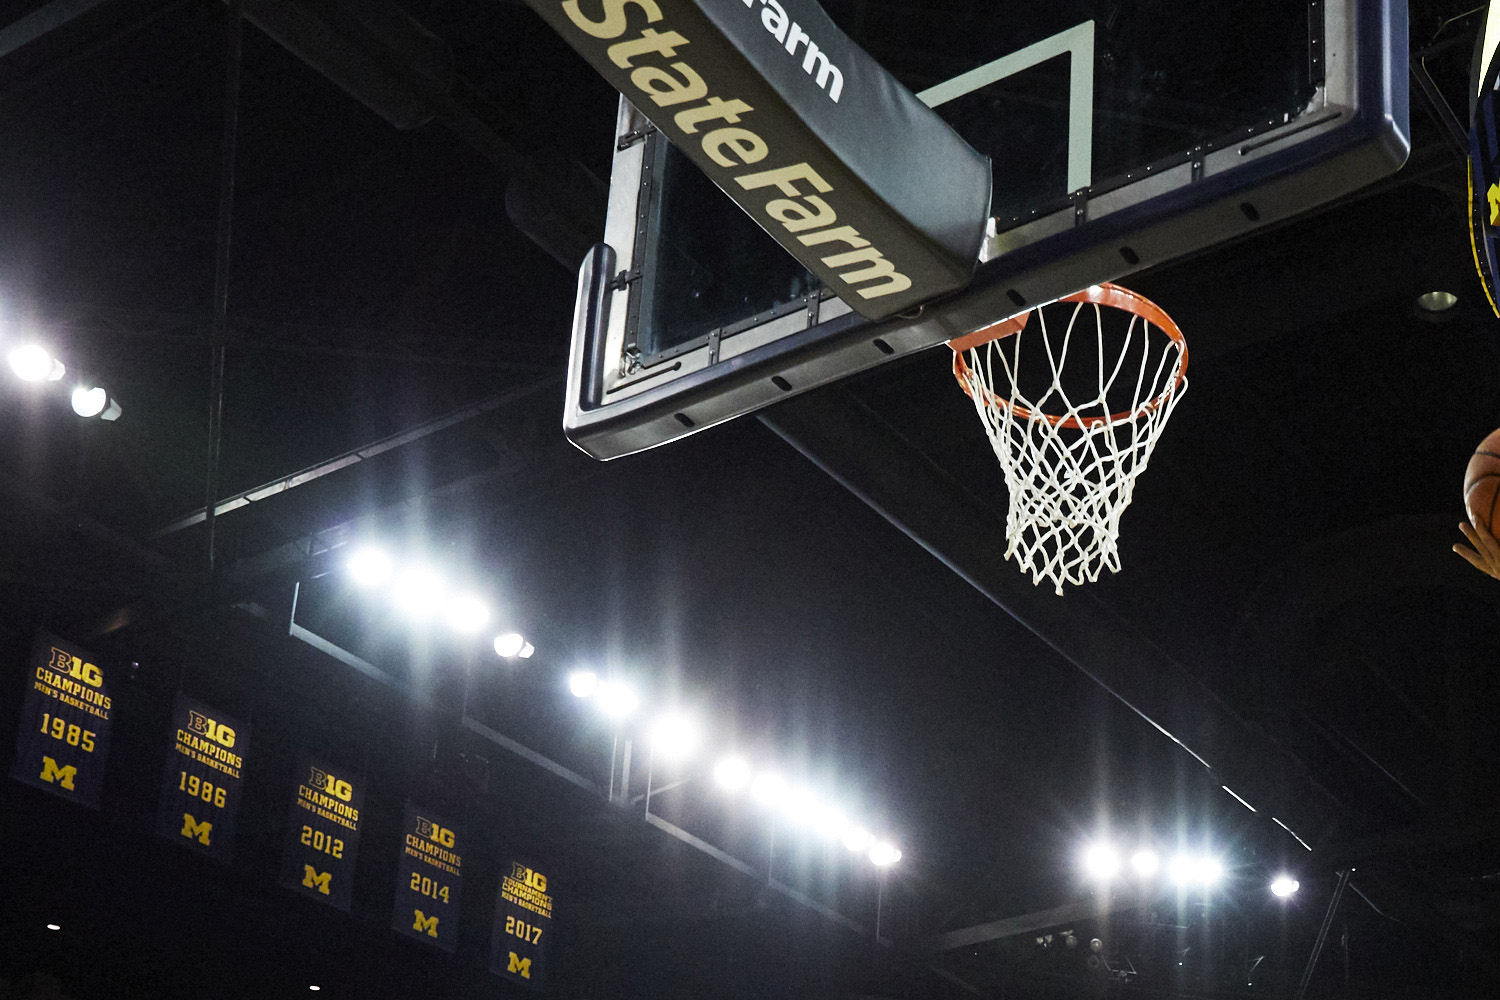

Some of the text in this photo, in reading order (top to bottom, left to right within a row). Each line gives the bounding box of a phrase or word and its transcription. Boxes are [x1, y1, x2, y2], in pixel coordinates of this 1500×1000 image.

[742, 0, 845, 103] arm
[36, 666, 111, 710] CHAMPIONS
[59, 692, 109, 720] BASKETBALL
[40, 713, 96, 752] 1985
[177, 728, 242, 769] CHAMPIONS
[39, 755, 77, 791] M
[197, 753, 241, 779] BASKETBALL
[179, 771, 227, 808] 1986
[298, 784, 359, 822] CHAMPIONS
[181, 813, 213, 846] M
[301, 825, 344, 859] 2012
[406, 833, 462, 867] CHAMPIONS
[302, 864, 332, 896] M
[411, 872, 450, 904] 2014
[501, 882, 553, 911] CHAMPIONS
[412, 909, 440, 938] M
[505, 915, 543, 945] 2017
[508, 951, 531, 980] M
